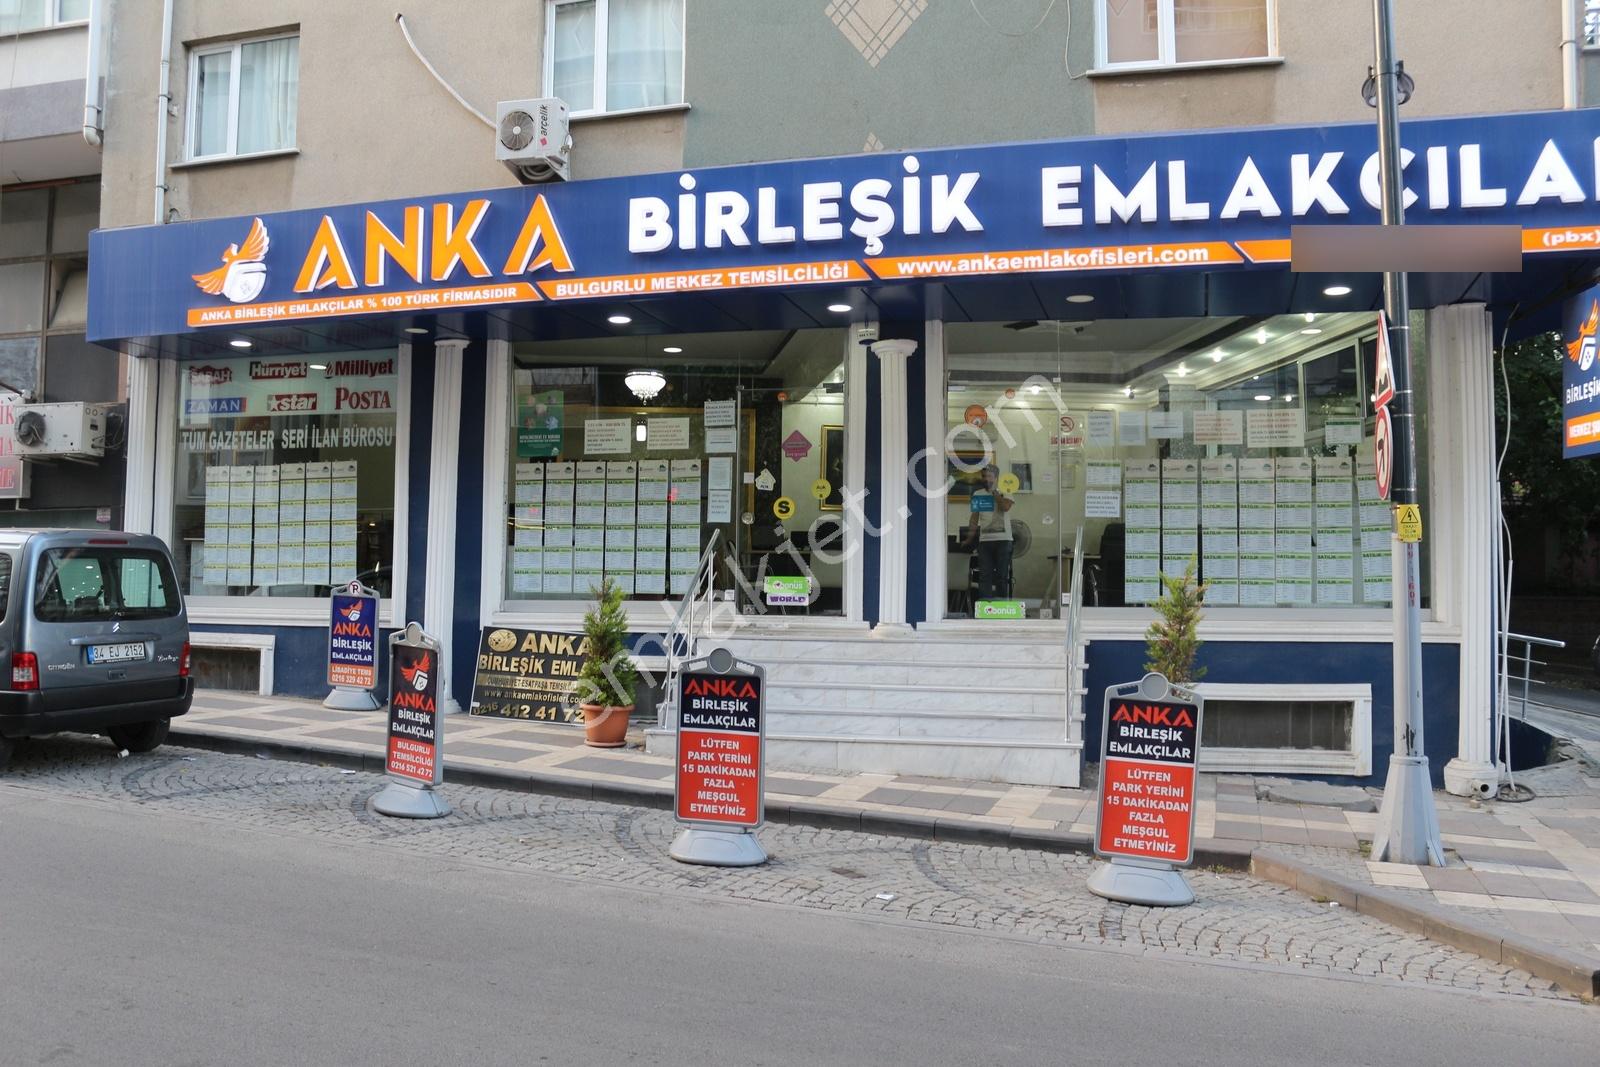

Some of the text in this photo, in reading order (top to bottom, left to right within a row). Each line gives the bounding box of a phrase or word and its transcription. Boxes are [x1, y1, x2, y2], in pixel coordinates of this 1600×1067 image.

[293, 193, 575, 293] ANKA
[628, 155, 984, 256] BİRLEŞİK
[897, 245, 1209, 275] www.ankaemlakofisleri.com
[556, 262, 850, 297] BULGURLU MERKEZ TEMSİLCİLİĞİ
[201, 287, 517, 322] ANKA BİRLEŞİK EMLAKÇILAR % 100 TÜRK FİRMASIDIR
[252, 363, 306, 379] Hürriyet
[335, 359, 393, 378] Milliyet
[188, 399, 240, 413] ZAMAN
[279, 395, 316, 411] star
[335, 387, 391, 410] POSTA
[209, 429, 274, 450] GAZETELER
[281, 425, 308, 449] SERİ
[312, 424, 338, 448] İLAN
[343, 424, 393, 448] BÜROSU
[333, 622, 371, 637] ANKA
[94, 644, 144, 659] 34 EJ 2152
[332, 637, 372, 652] BİRLEŞİK
[520, 633, 592, 656] ANKA
[332, 651, 372, 662] EMLAKÇILAR
[479, 652, 545, 676] BİRLEŞİK
[684, 678, 757, 699] ANKA
[393, 691, 435, 712] ANKA
[692, 697, 749, 714] BİRLEŞİK
[398, 708, 431, 725] BİRLEŞİK
[500, 704, 531, 718] 412
[535, 706, 557, 721] 41
[563, 708, 586, 723] 72
[683, 714, 756, 729] EMLAKÇILAR
[1112, 703, 1193, 727] ANKA
[392, 722, 434, 739] EMLAKÇILAR
[1120, 724, 1183, 743] BİRLEŞİK
[397, 741, 430, 755] BULGURLU
[701, 737, 739, 750] LÜTFEN
[1110, 741, 1191, 759] EMLAKÇILAR
[393, 751, 433, 767] TEMSİLCİLİĞİ
[687, 751, 751, 765] PARK YERİNİ
[682, 764, 756, 778] 15 DAKİKADAN
[1127, 768, 1171, 782] LÜTFEN
[703, 778, 735, 789] FAZLA
[1113, 782, 1184, 798] PARK YERİNİ
[697, 790, 740, 803] MEŞGUL
[1106, 795, 1189, 812] 15 DAKİKADAN
[690, 803, 746, 816] ETMEYİNİZ
[1129, 812, 1164, 824] FAZLA
[1122, 825, 1169, 838] MEŞGUL
[1114, 838, 1176, 853] ETMEYİNİZ
